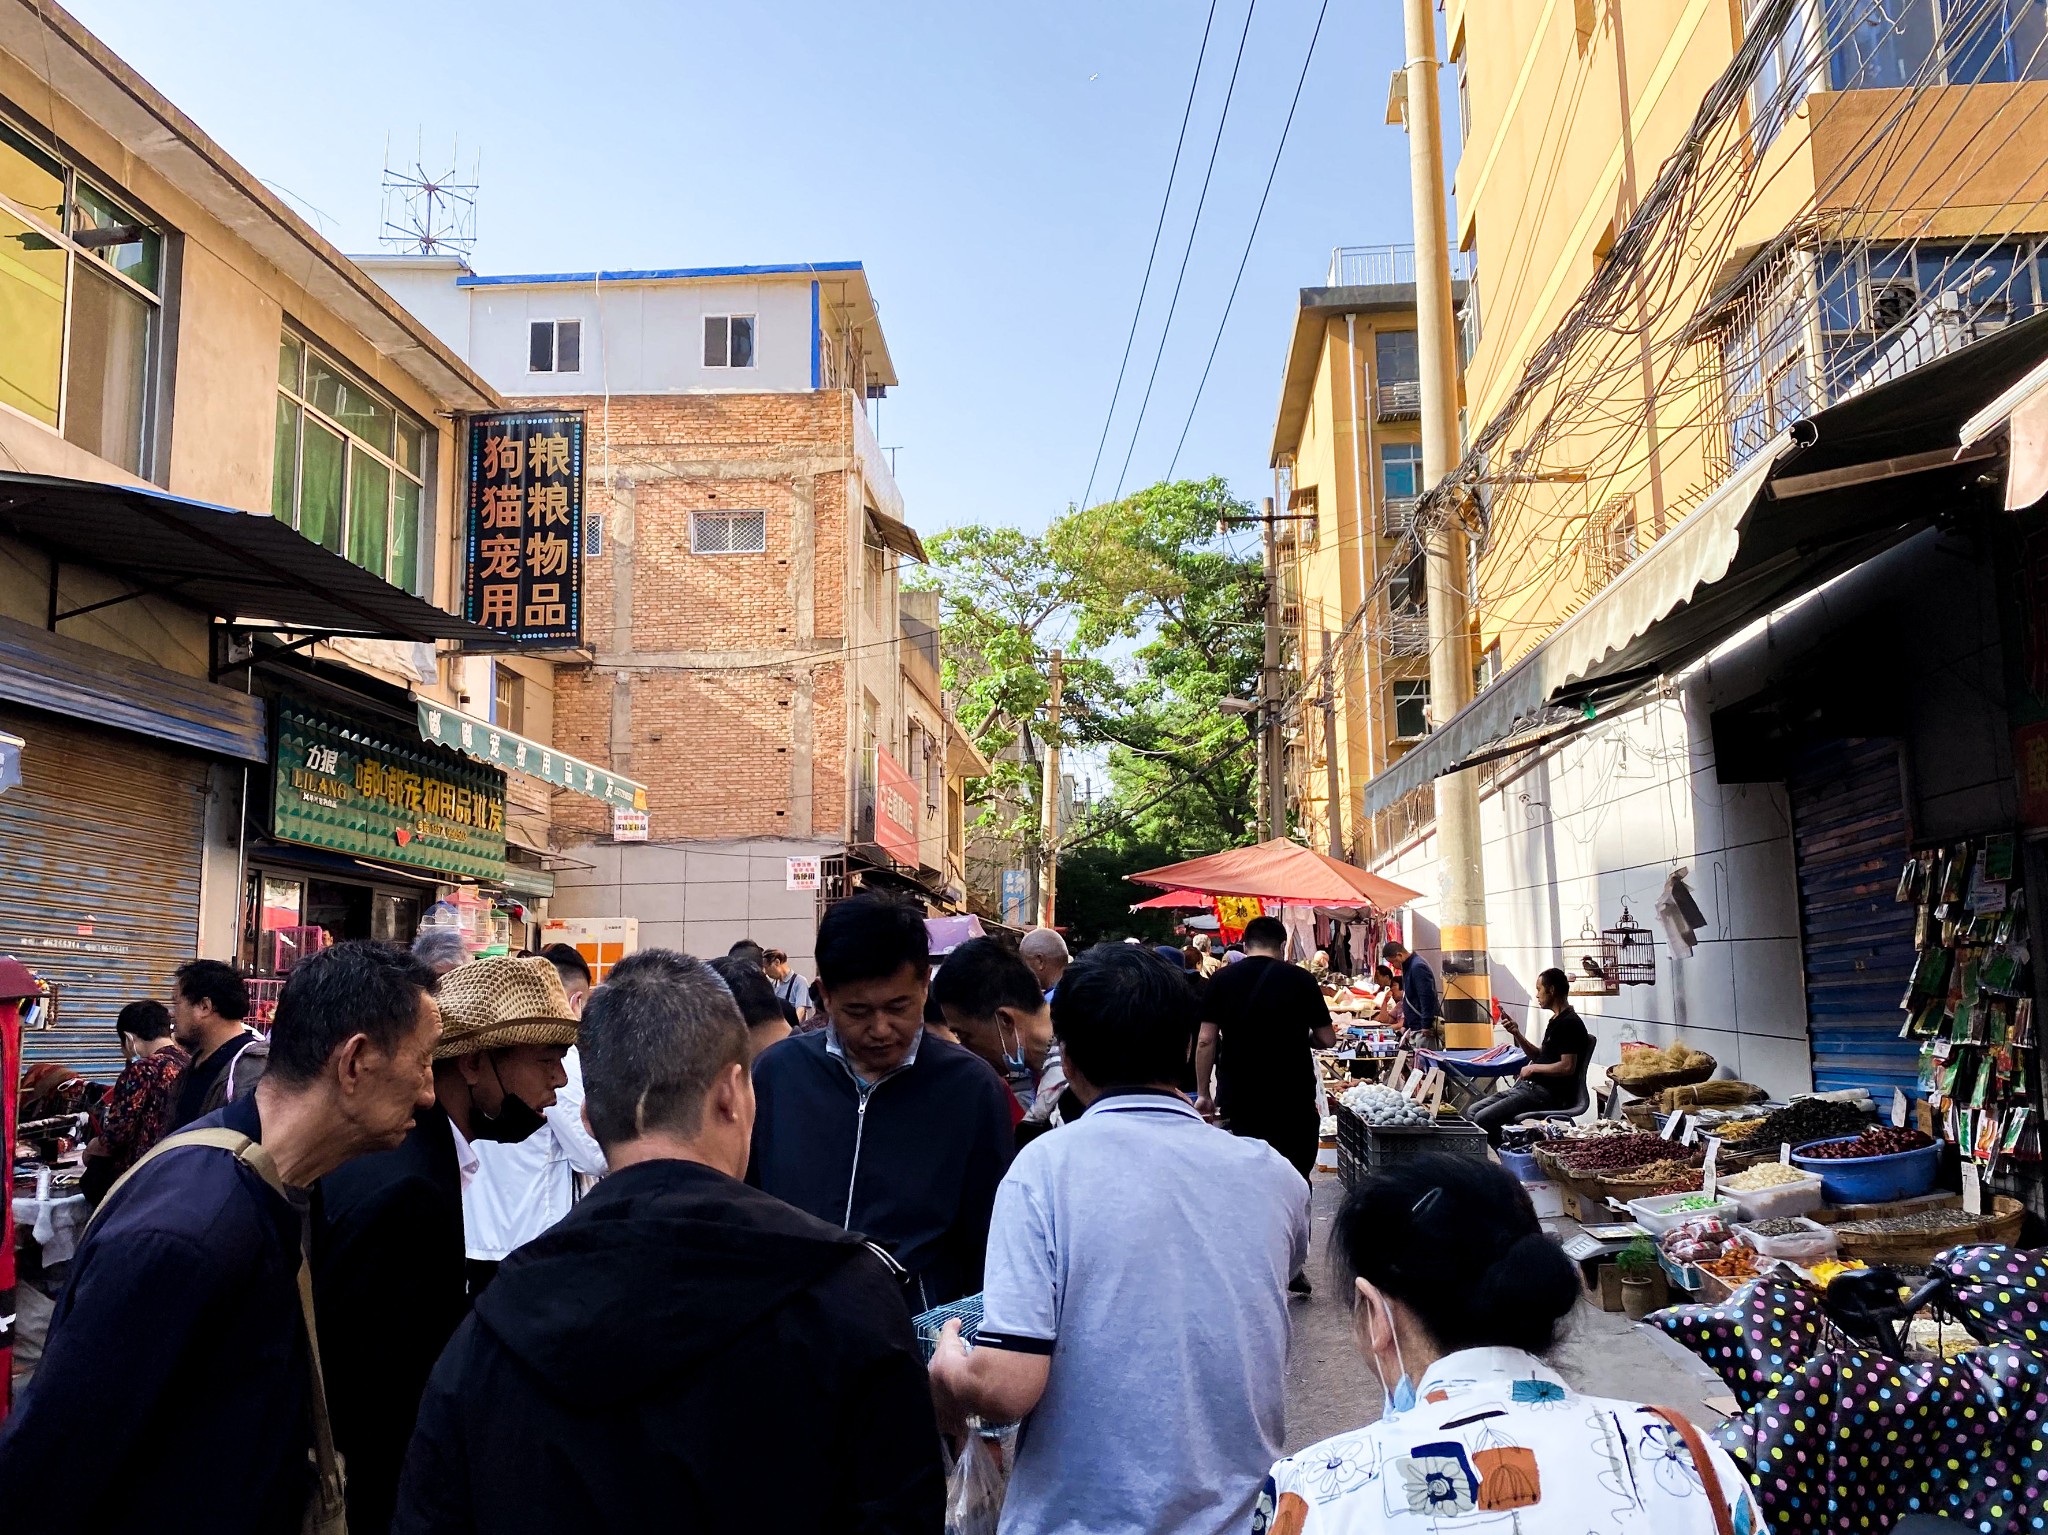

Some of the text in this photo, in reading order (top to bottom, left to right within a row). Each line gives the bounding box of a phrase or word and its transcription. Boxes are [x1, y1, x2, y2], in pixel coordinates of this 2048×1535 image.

[483, 432, 571, 479] 狗粮
[481, 481, 571, 529] 猫粮
[479, 531, 569, 579] 宠物
[477, 582, 566, 628] 用品
[294, 770, 347, 800] LILANG
